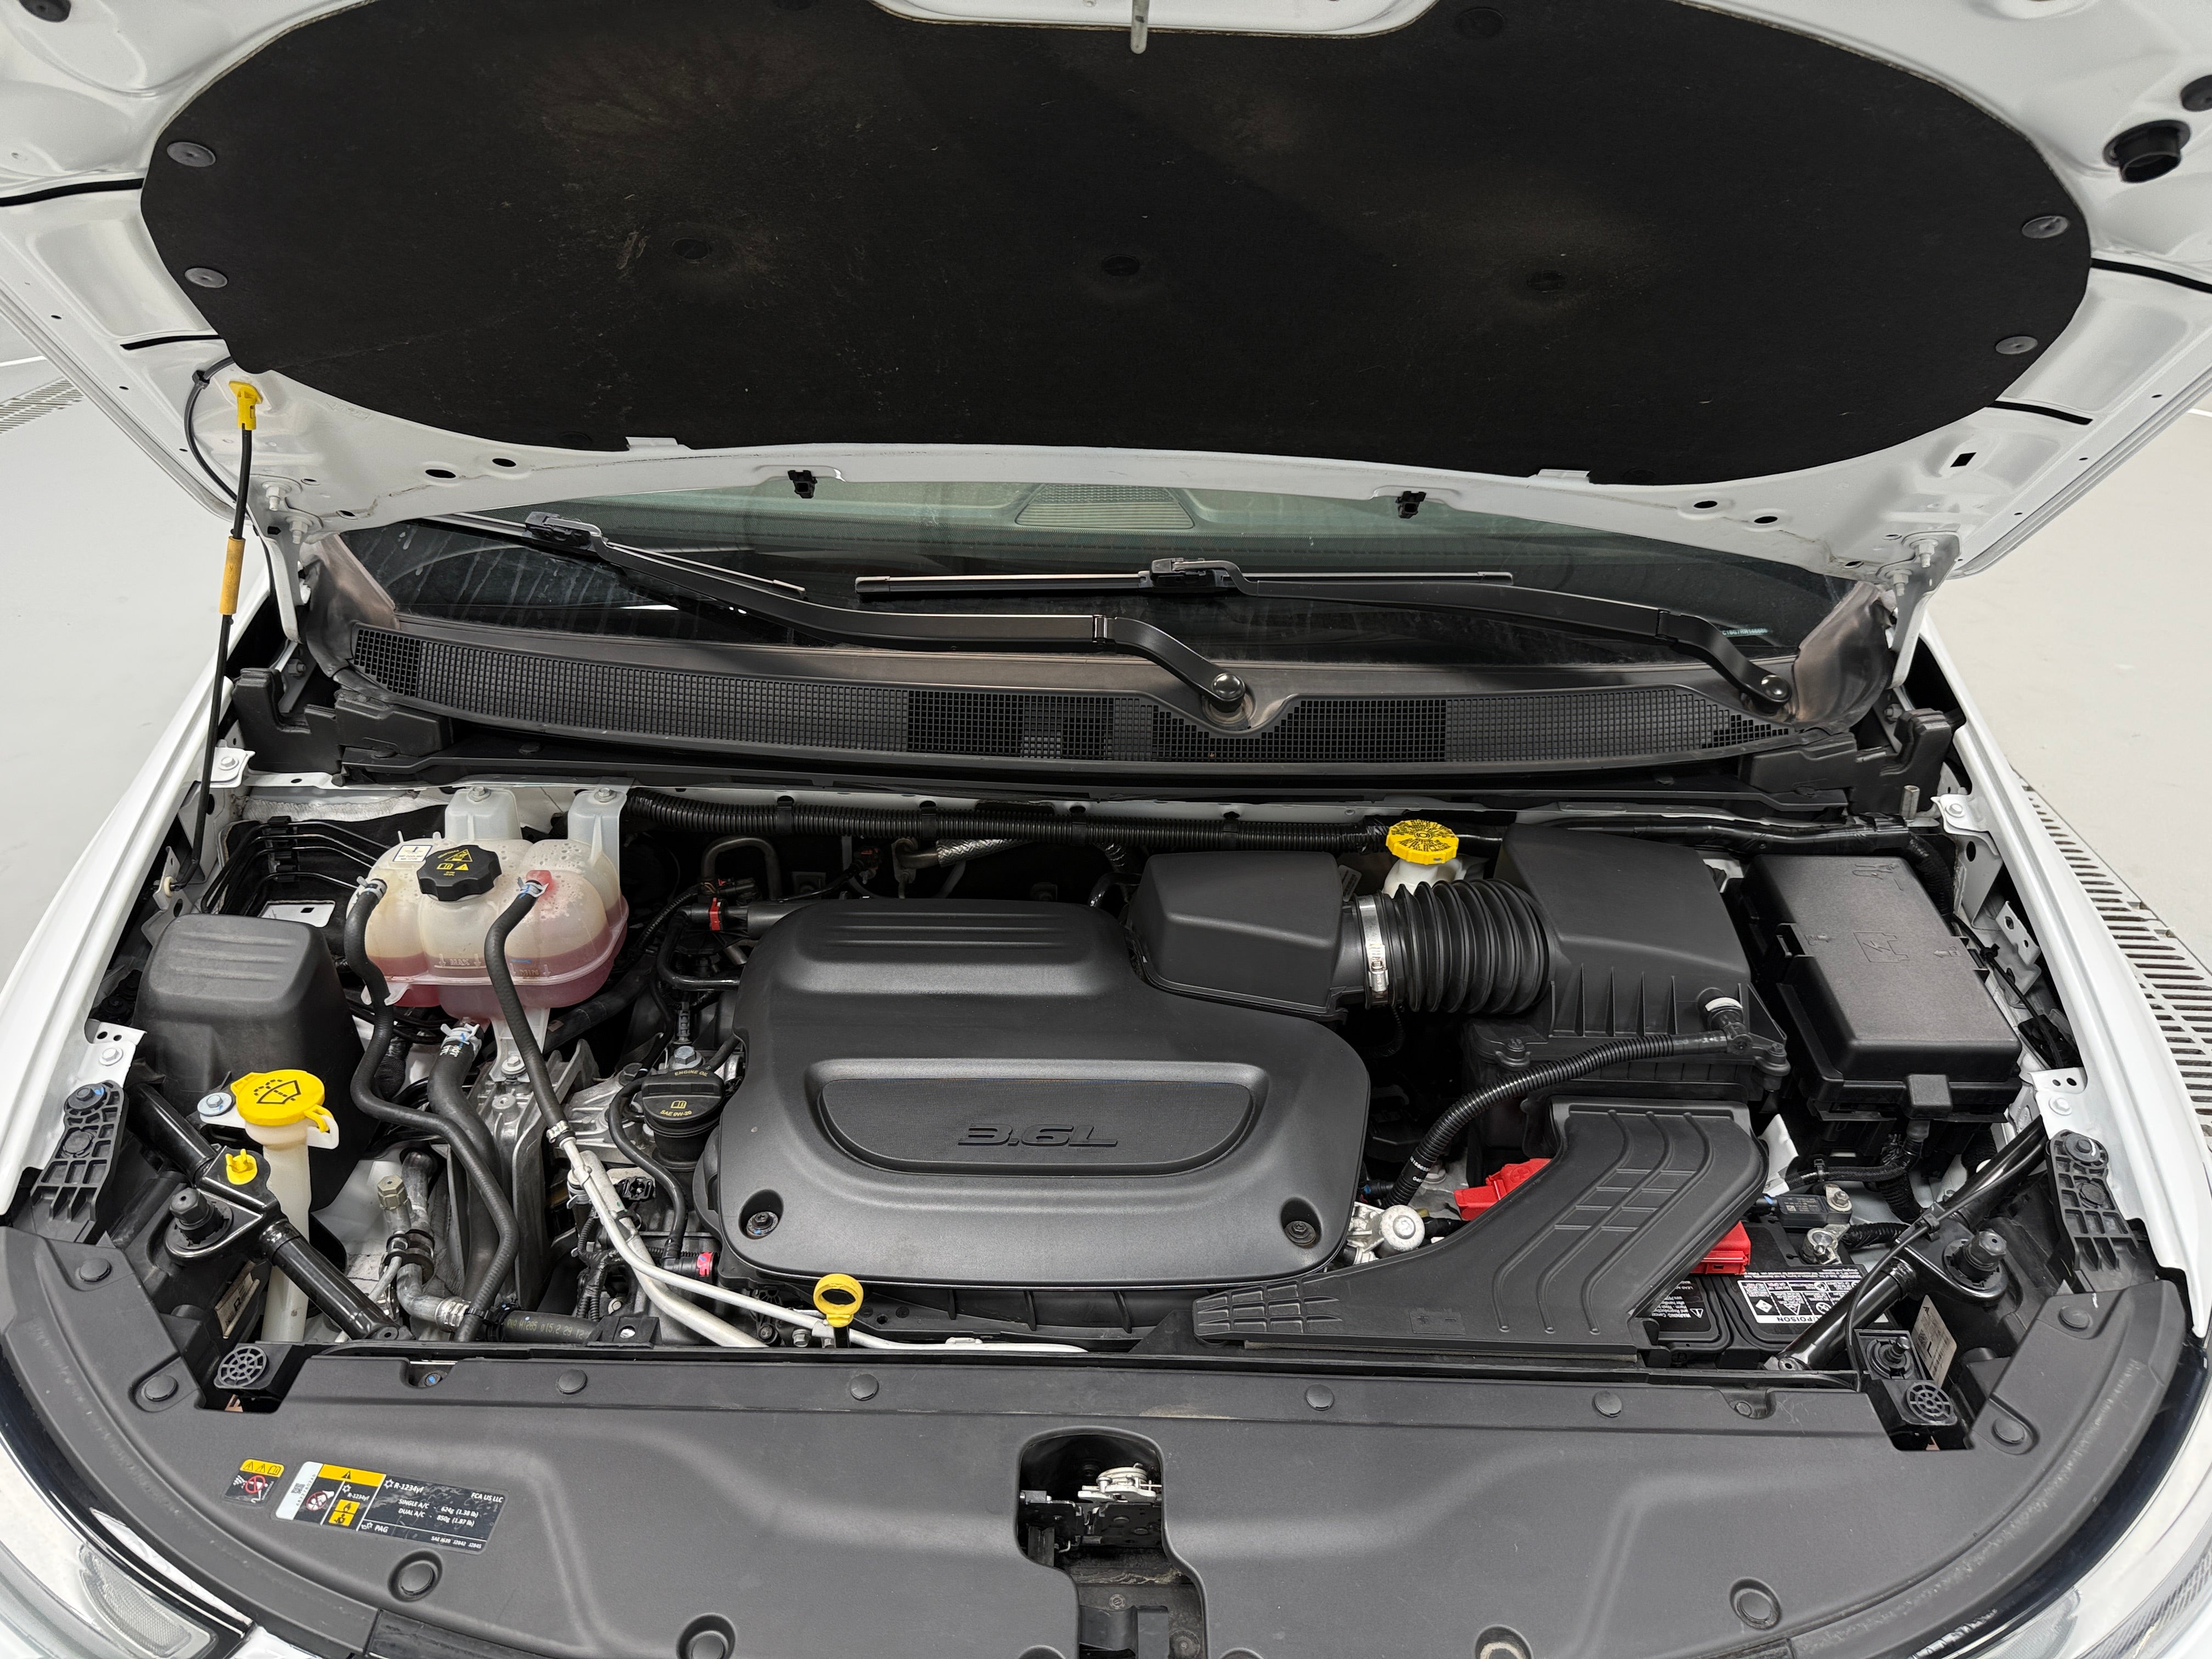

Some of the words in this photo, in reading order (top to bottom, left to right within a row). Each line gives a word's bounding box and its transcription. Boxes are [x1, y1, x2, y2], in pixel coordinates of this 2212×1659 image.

[957, 1123, 1119, 1147] 3.6L
[393, 1482, 425, 1494] R-1234yf
[347, 1492, 370, 1502] R-1234yf
[398, 1498, 418, 1508] SINGLE
[441, 1506, 454, 1515] 624g
[398, 1508, 414, 1516] DUAL
[437, 1515, 450, 1523] 850g
[466, 1519, 475, 1527] lb)
[374, 1525, 389, 1533] PAG
